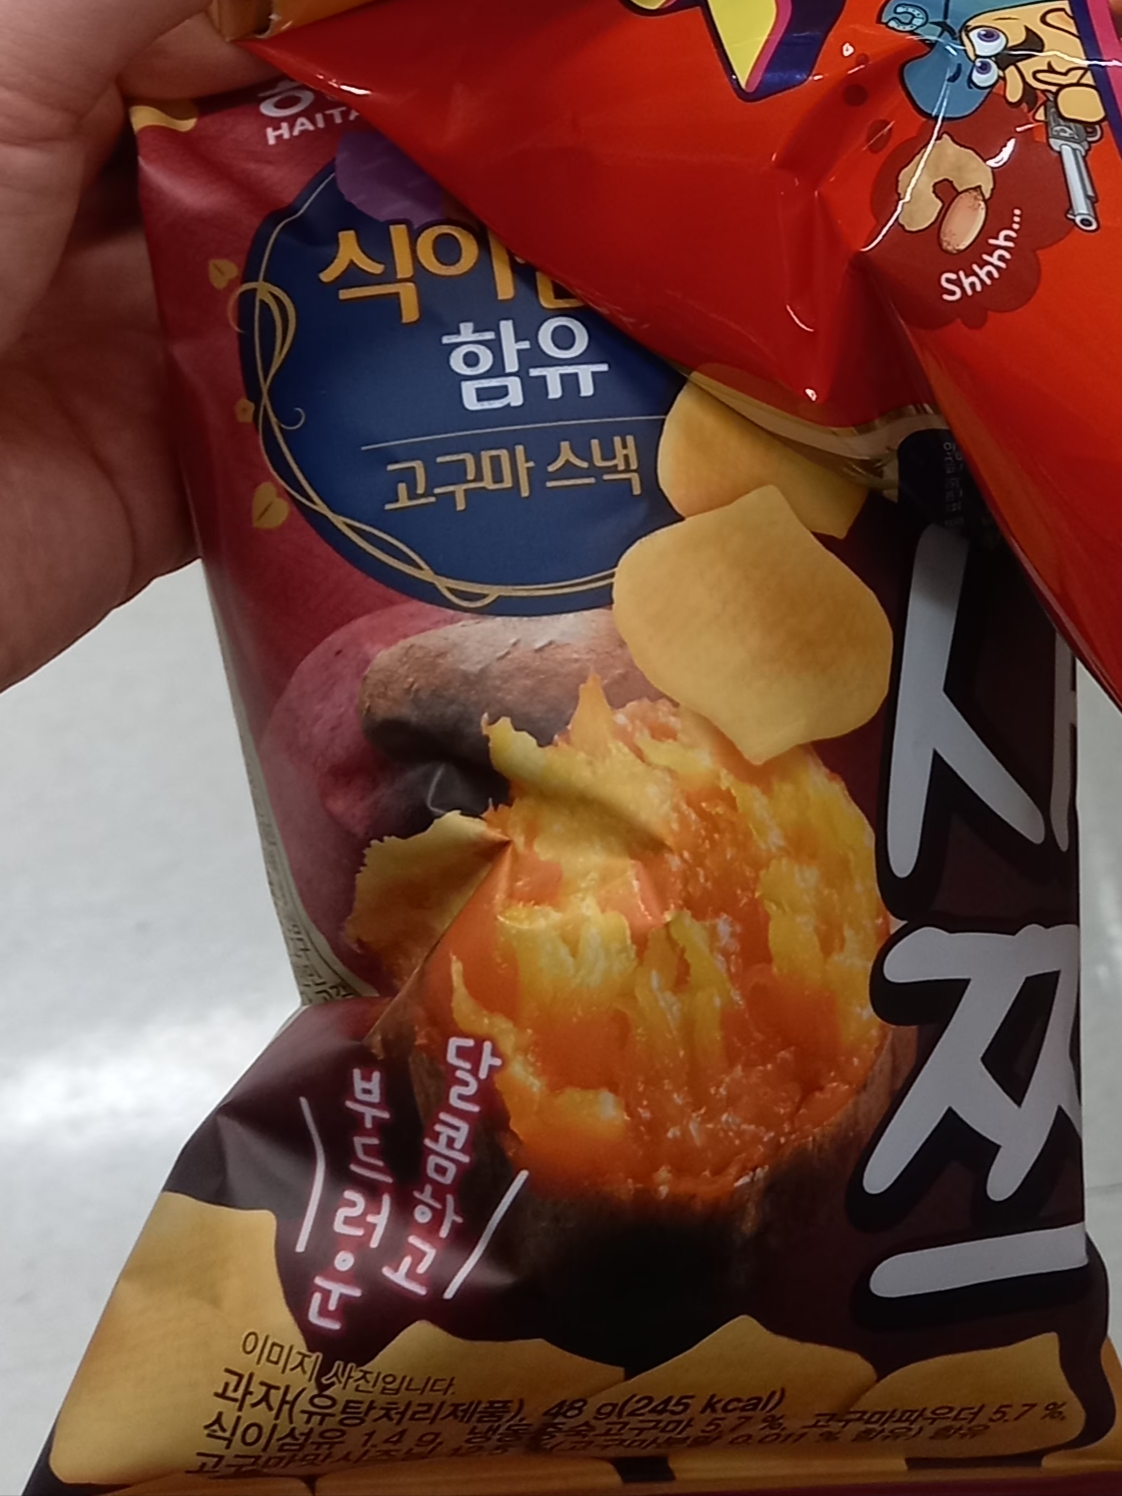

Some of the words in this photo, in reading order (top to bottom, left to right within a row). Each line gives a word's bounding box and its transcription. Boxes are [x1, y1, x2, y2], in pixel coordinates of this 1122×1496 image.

[441, 315, 610, 412] 함유
[384, 444, 535, 512] 고구마
[545, 434, 642, 496] 스낵
[307, 1067, 393, 1331] 부드러운
[383, 1036, 502, 1295] 달콤하고
[242, 1331, 323, 1384] 이미지
[202, 1411, 348, 1452] 식이섬유
[359, 1428, 407, 1450] 1.4
[801, 1403, 986, 1430] 고구마파우더
[987, 1402, 1039, 1424] 5.7
[542, 1398, 588, 1420] 48
[593, 1393, 696, 1422] g(245
[700, 1386, 786, 1412] kcal)
